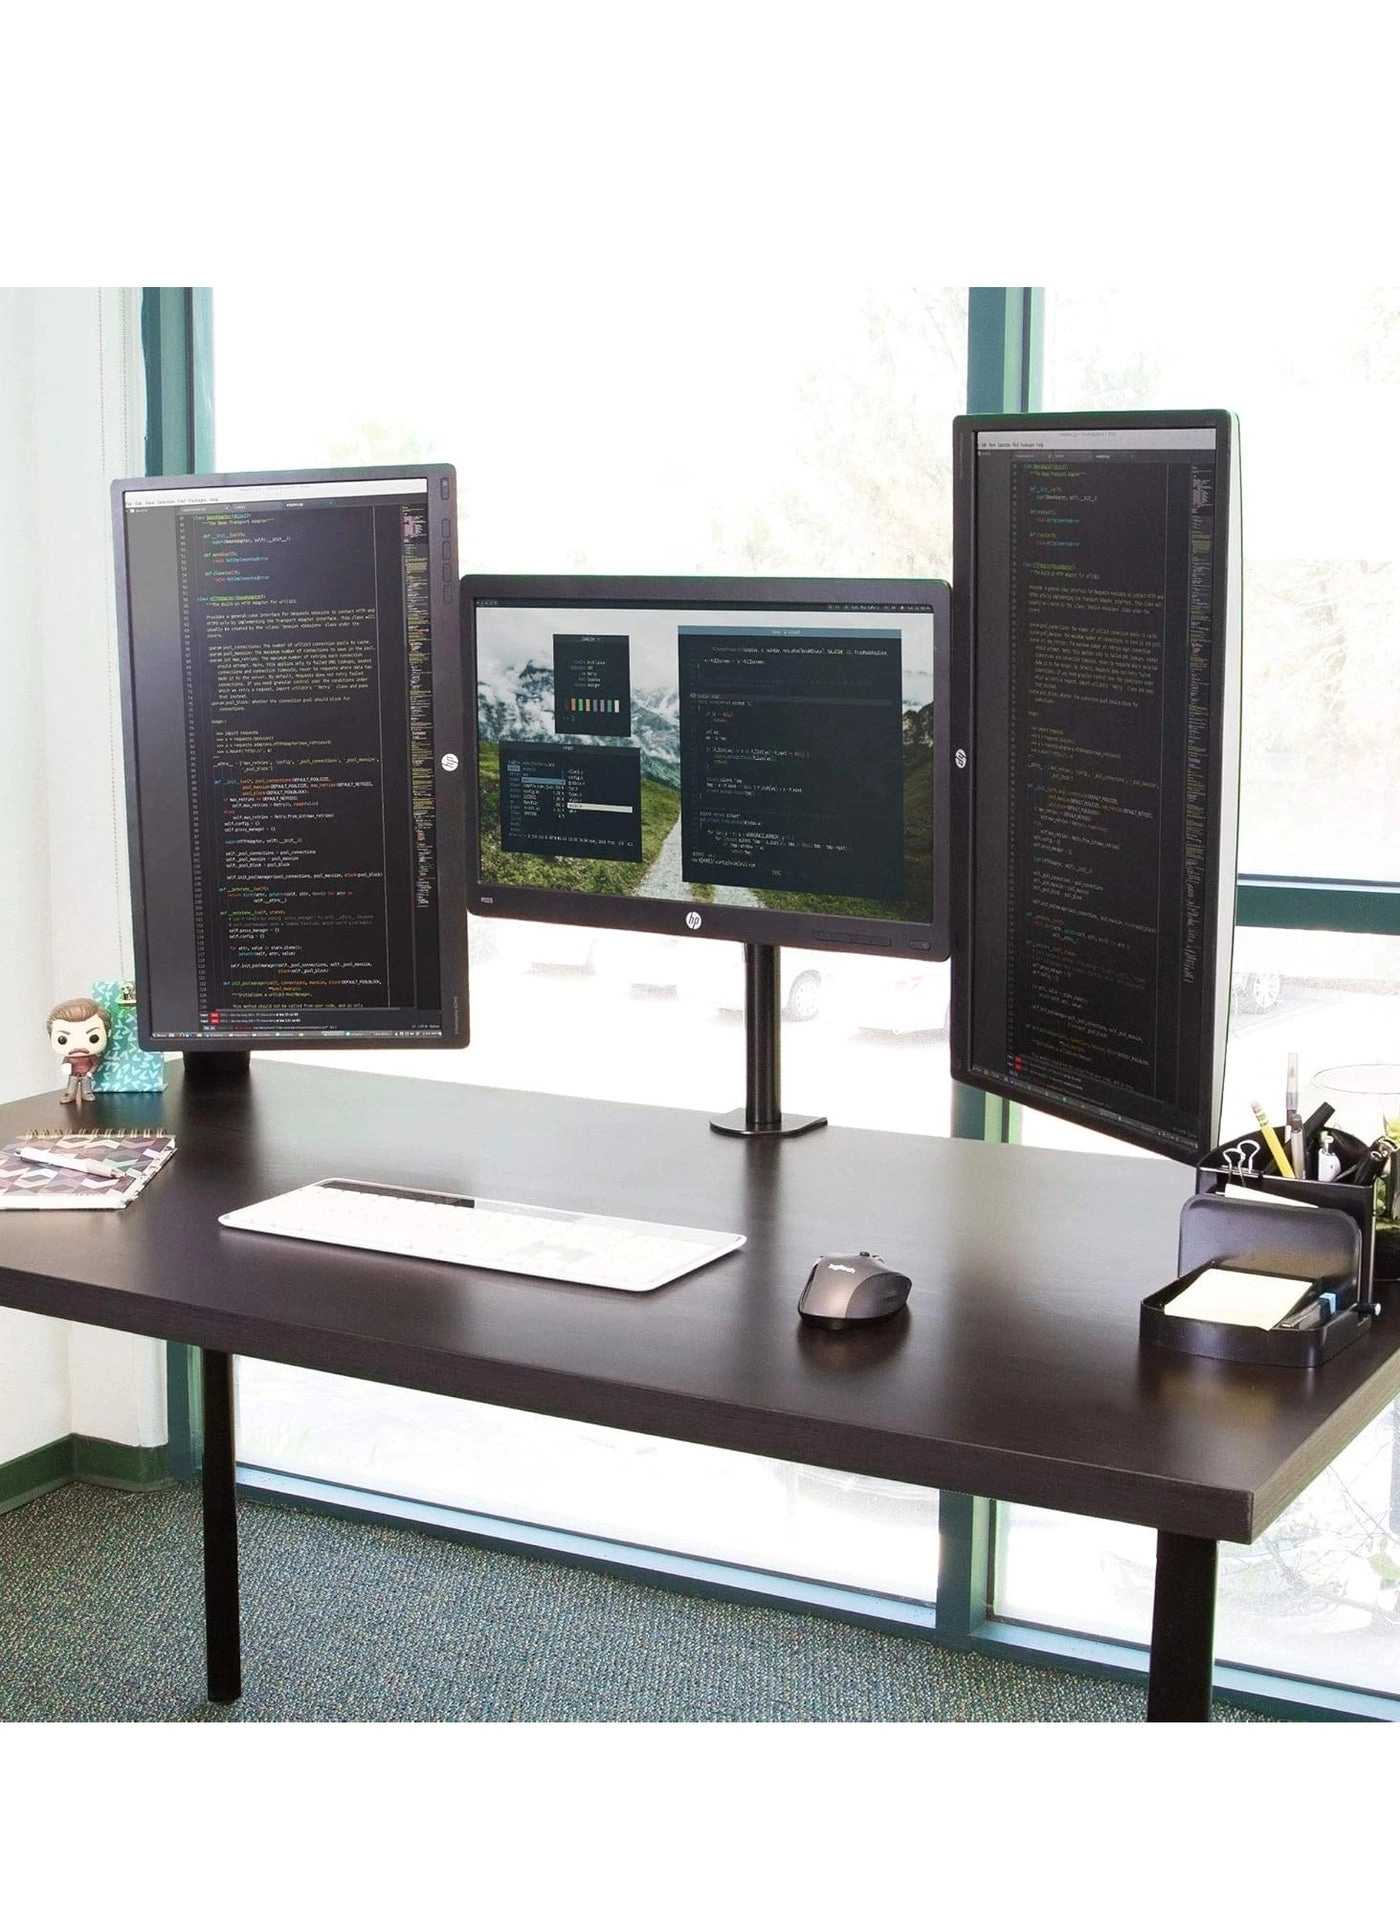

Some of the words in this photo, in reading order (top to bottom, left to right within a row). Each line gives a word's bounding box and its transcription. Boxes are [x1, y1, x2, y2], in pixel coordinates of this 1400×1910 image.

[442, 755, 459, 770] hp
[956, 751, 967, 768] hp
[687, 912, 701, 930] hp
